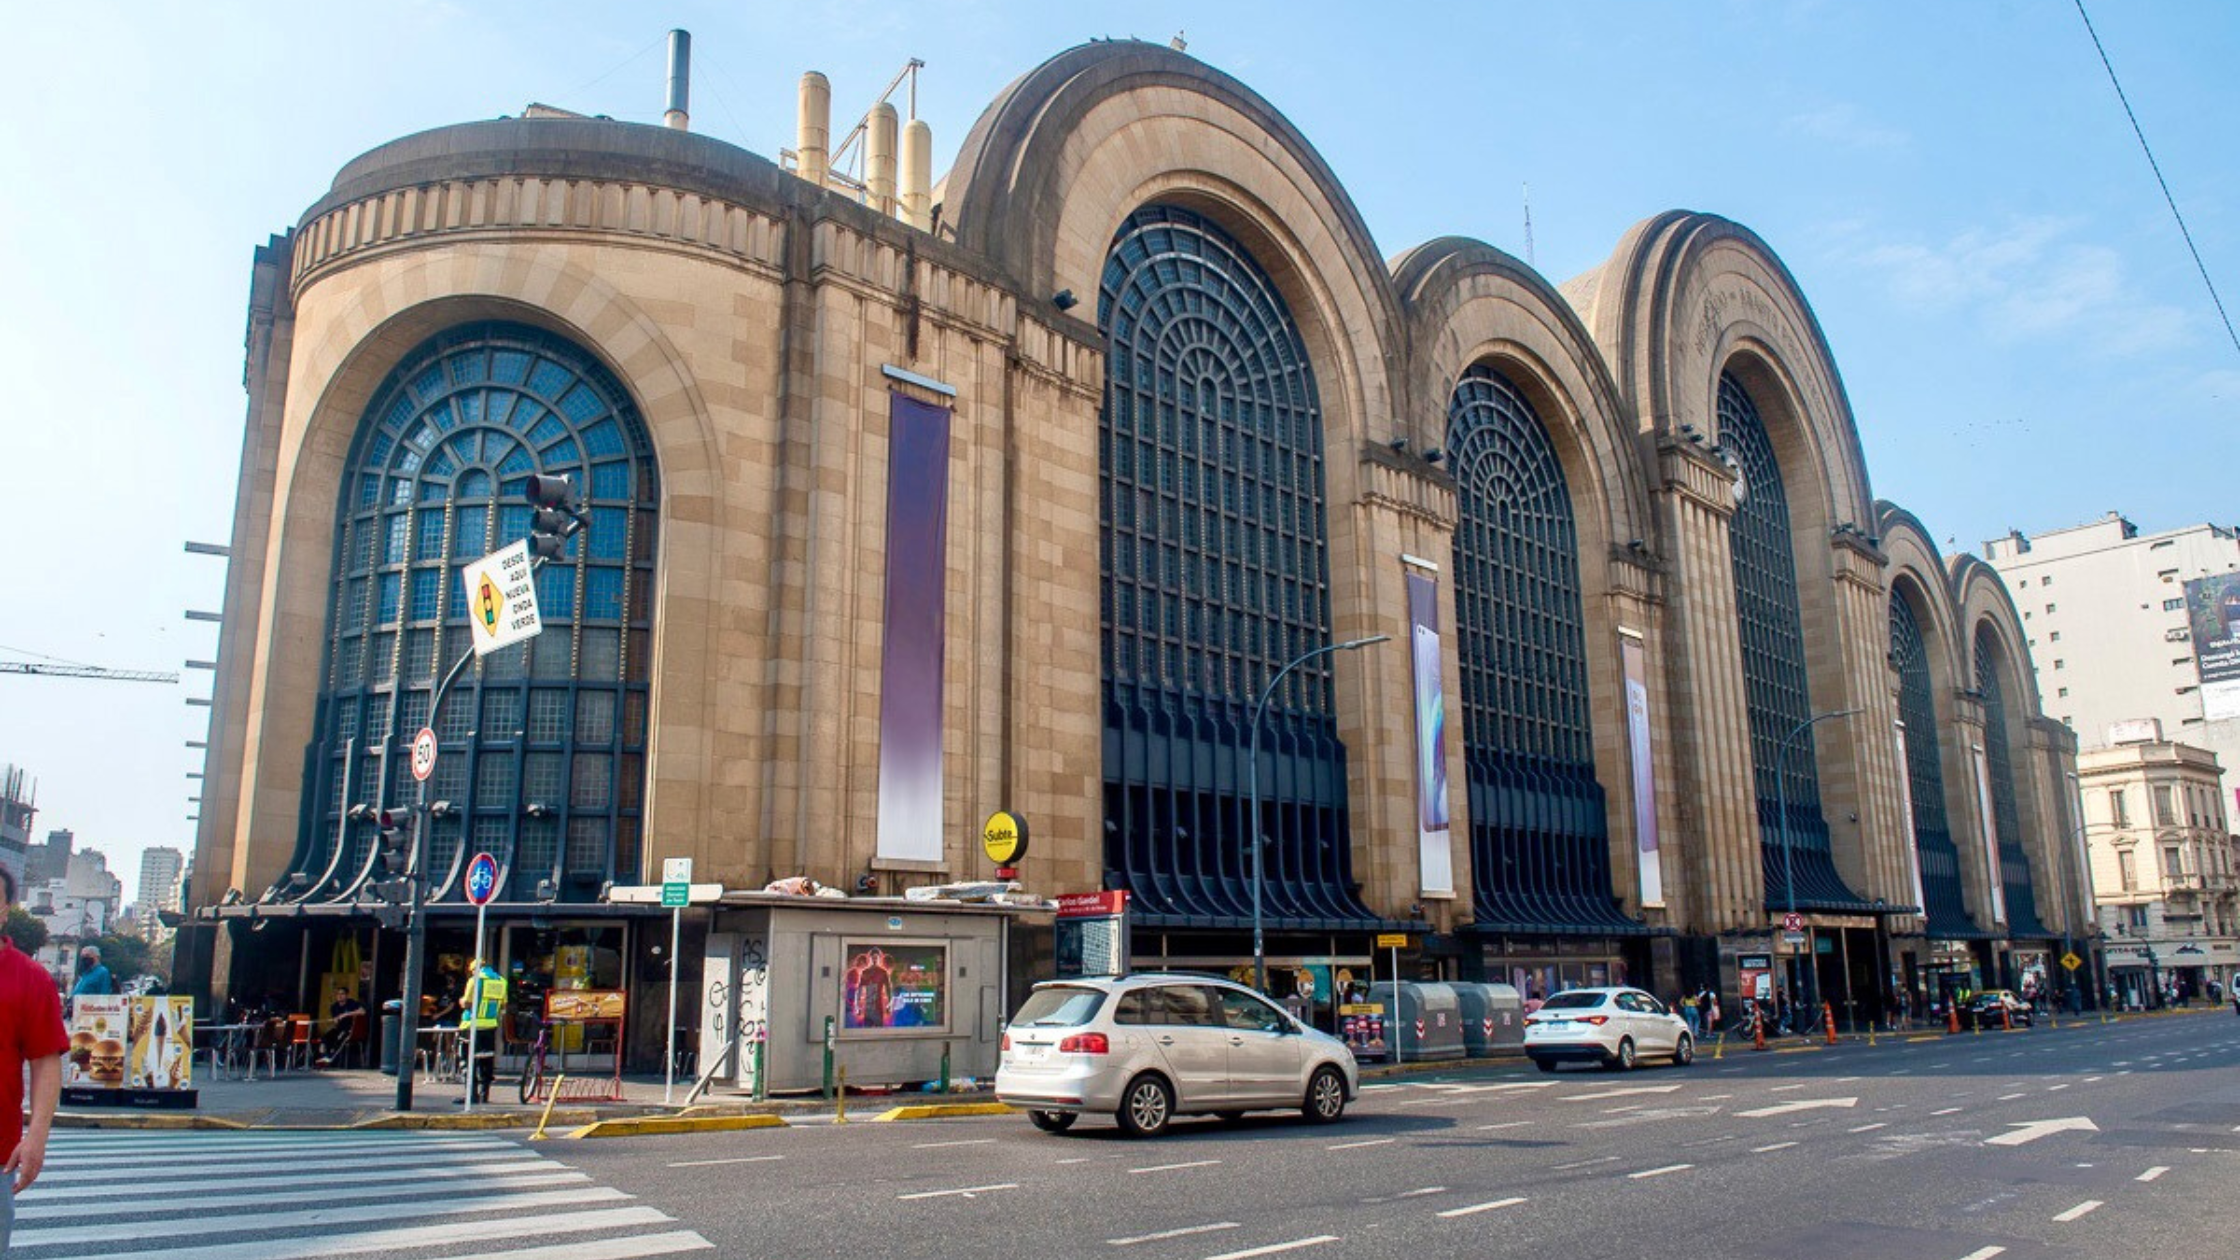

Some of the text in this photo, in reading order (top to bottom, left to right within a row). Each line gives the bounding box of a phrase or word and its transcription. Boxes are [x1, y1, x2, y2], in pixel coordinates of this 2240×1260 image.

[502, 552, 524, 570] DESDE
[505, 583, 530, 600] NUEVA
[513, 598, 533, 614] ONDA
[511, 613, 535, 630] VERDE
[417, 742, 430, 764] 50
[987, 828, 1012, 842] Subte
